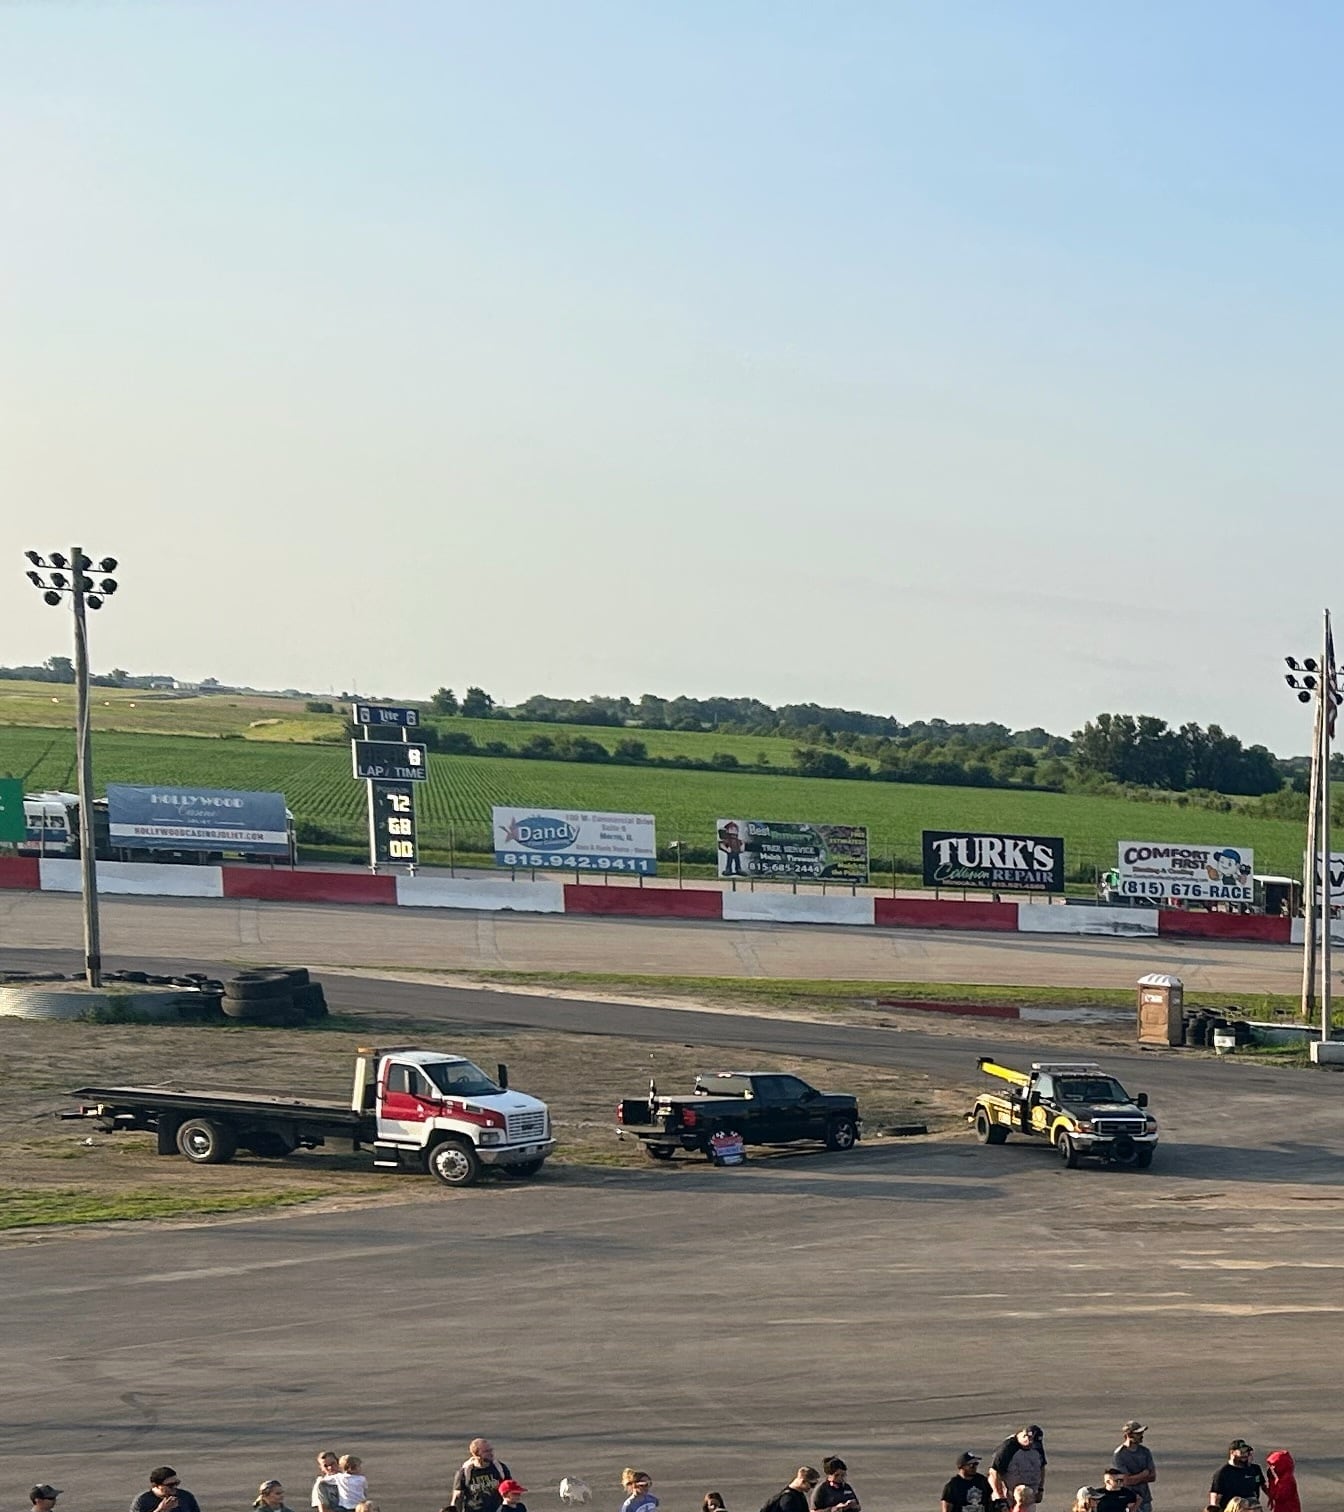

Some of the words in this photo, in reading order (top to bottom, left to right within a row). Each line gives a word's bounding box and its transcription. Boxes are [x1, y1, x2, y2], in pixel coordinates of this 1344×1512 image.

[379, 709, 400, 721] Lite
[394, 766, 426, 779] TIME
[151, 794, 245, 808] HOLLYWOOD
[518, 824, 580, 841] Dandy
[749, 824, 770, 836] Best
[932, 837, 1054, 871] TURK'S
[1124, 847, 1210, 864] COMFORT
[503, 853, 649, 871] 815.942.9411
[749, 862, 820, 874] 815-685-2444
[1171, 858, 1207, 869] FIRST
[933, 861, 990, 880] Collision
[992, 869, 1053, 882] REPAIR
[1122, 881, 1164, 896] (815)
[1171, 883, 1252, 899] 676-RACE
